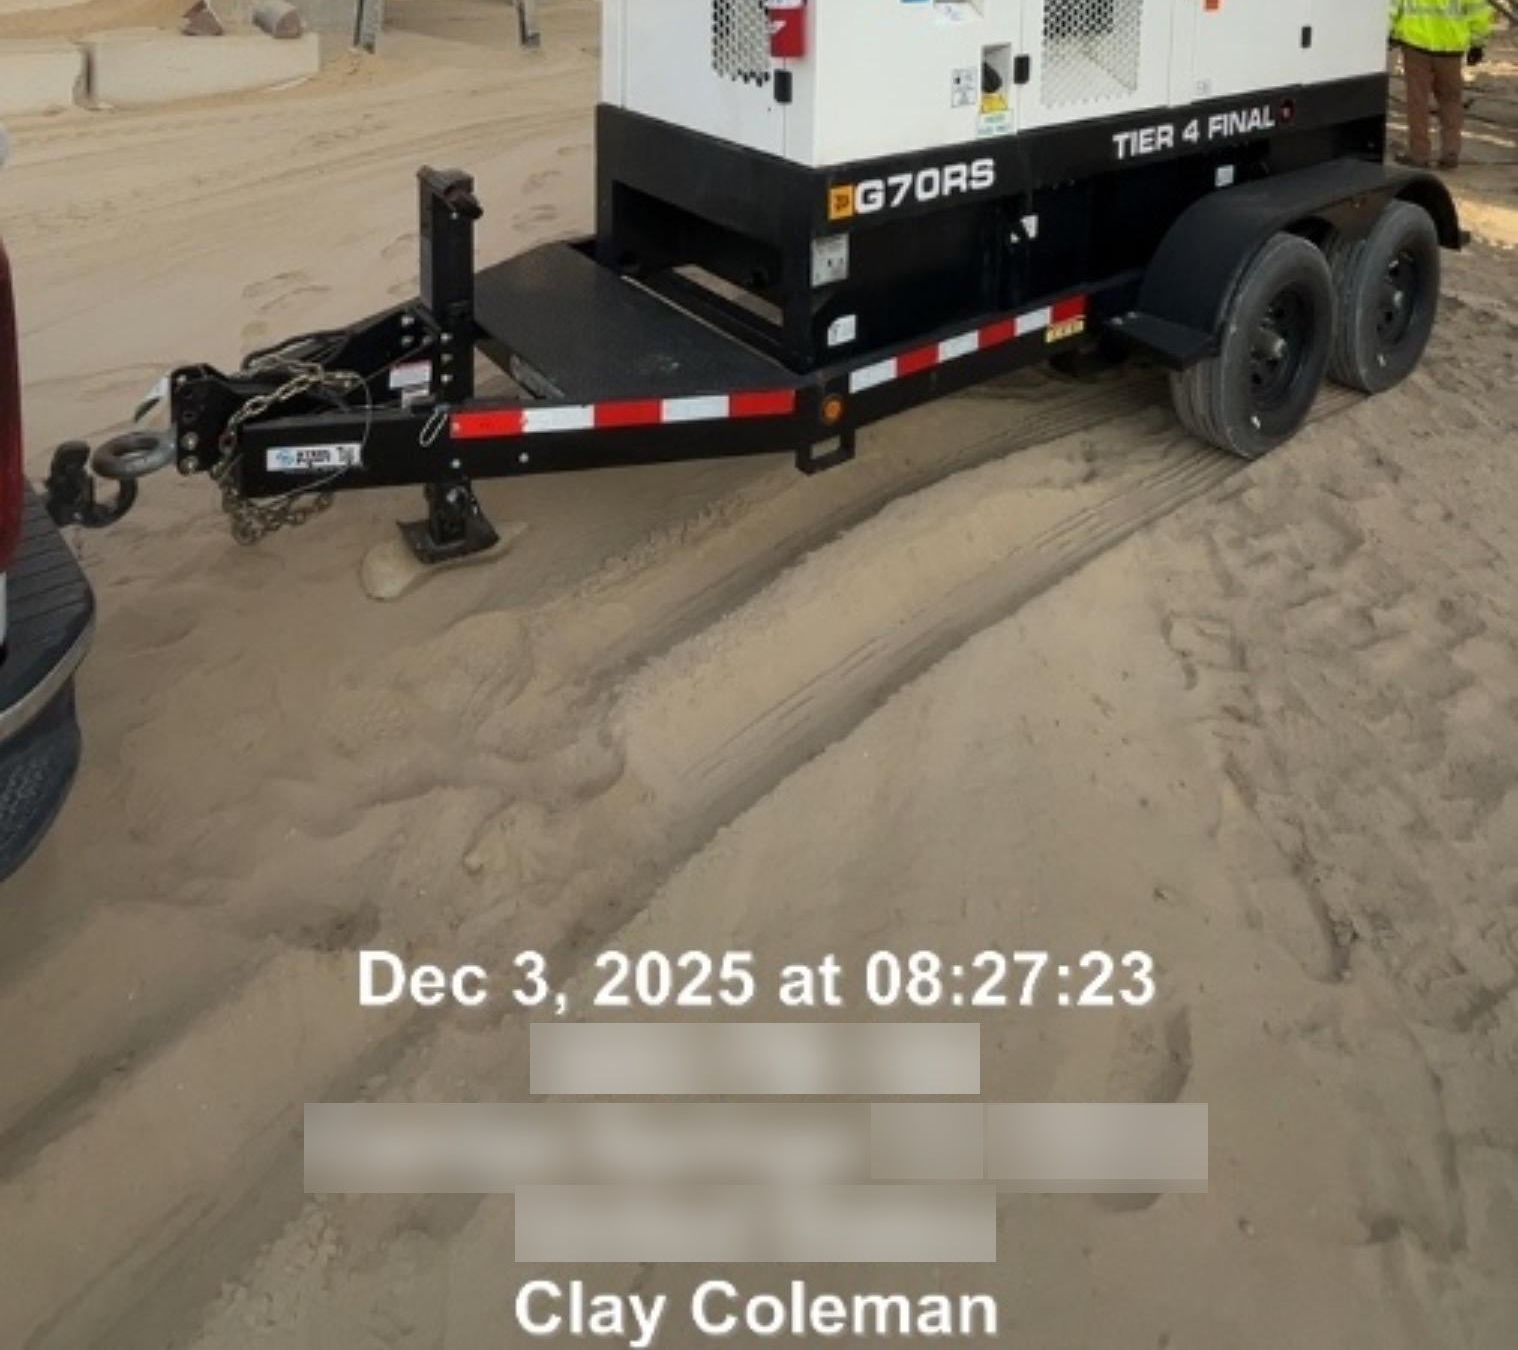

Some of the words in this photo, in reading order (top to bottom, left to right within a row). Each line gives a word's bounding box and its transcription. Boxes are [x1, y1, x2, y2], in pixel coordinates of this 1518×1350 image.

[1112, 124, 1174, 160] TIER
[1181, 118, 1200, 144] 4
[1207, 105, 1276, 141] FINAL
[854, 158, 996, 215] G70RS
